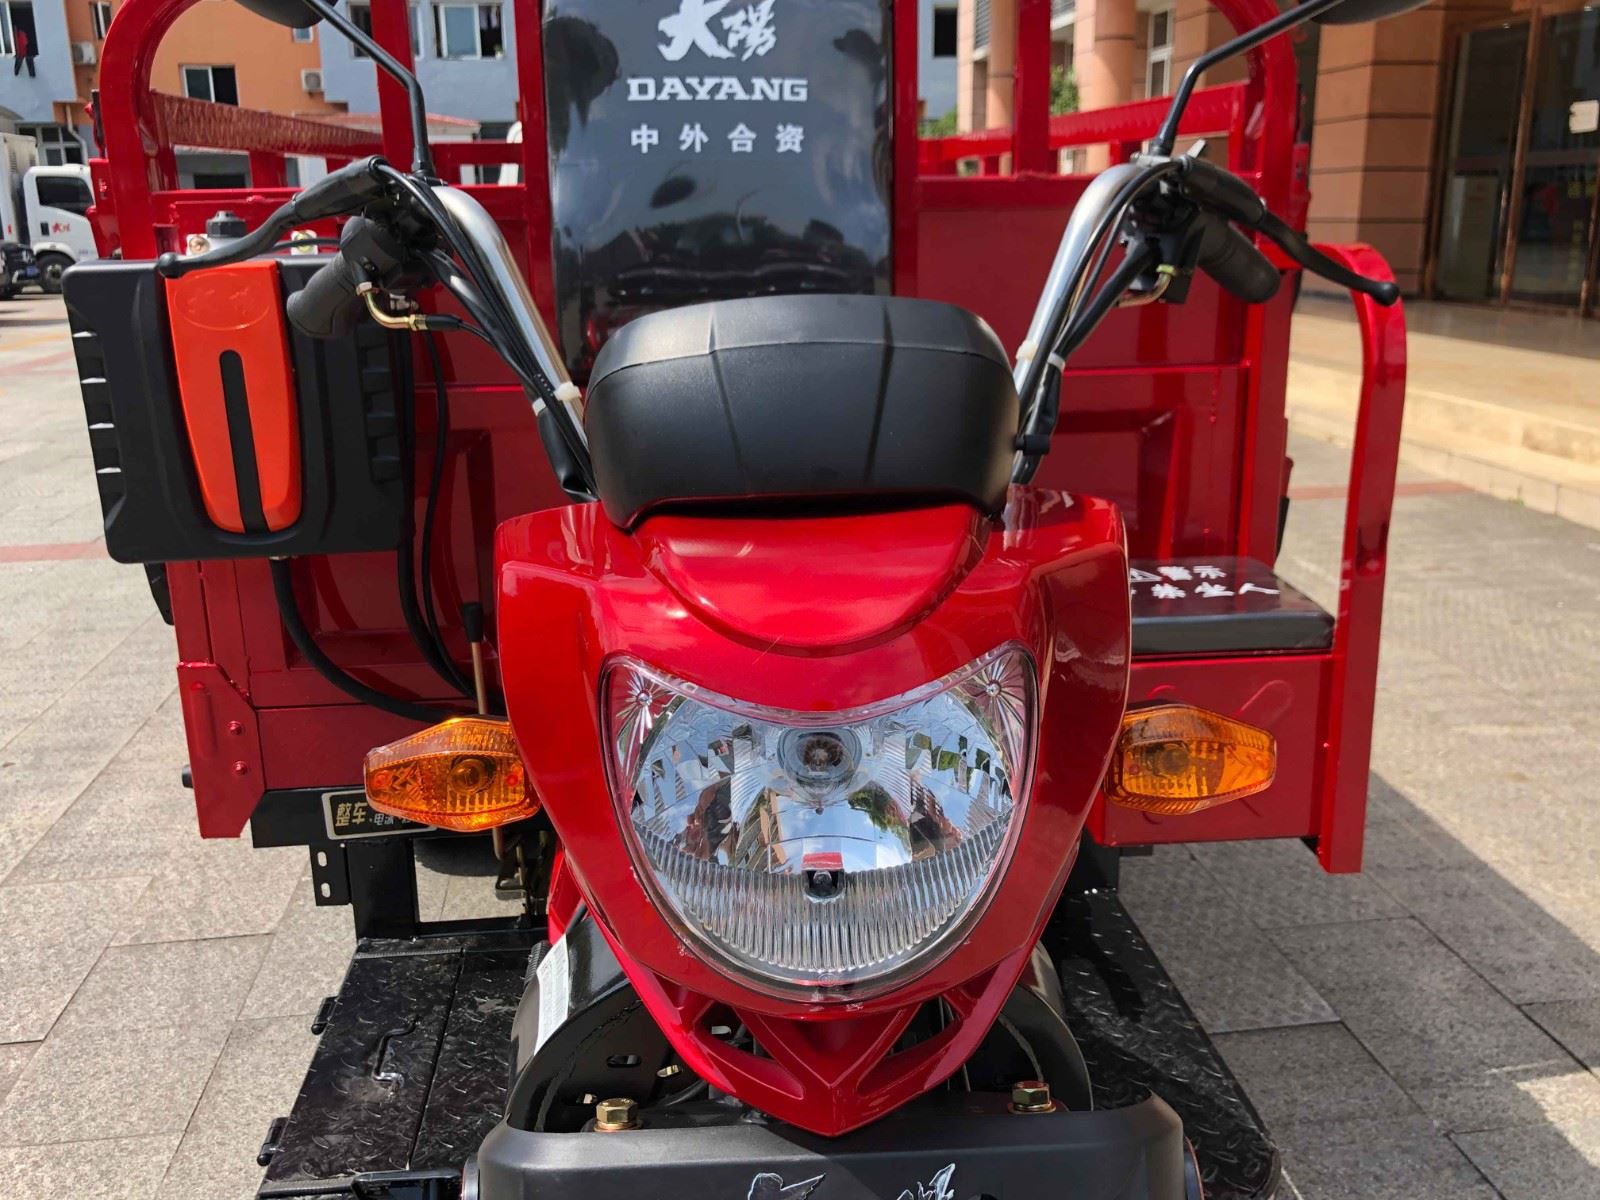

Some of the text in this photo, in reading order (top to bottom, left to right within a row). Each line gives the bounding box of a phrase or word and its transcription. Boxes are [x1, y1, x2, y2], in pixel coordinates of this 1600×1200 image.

[627, 77, 808, 101] DAYANG
[631, 123, 804, 154] 中外合资
